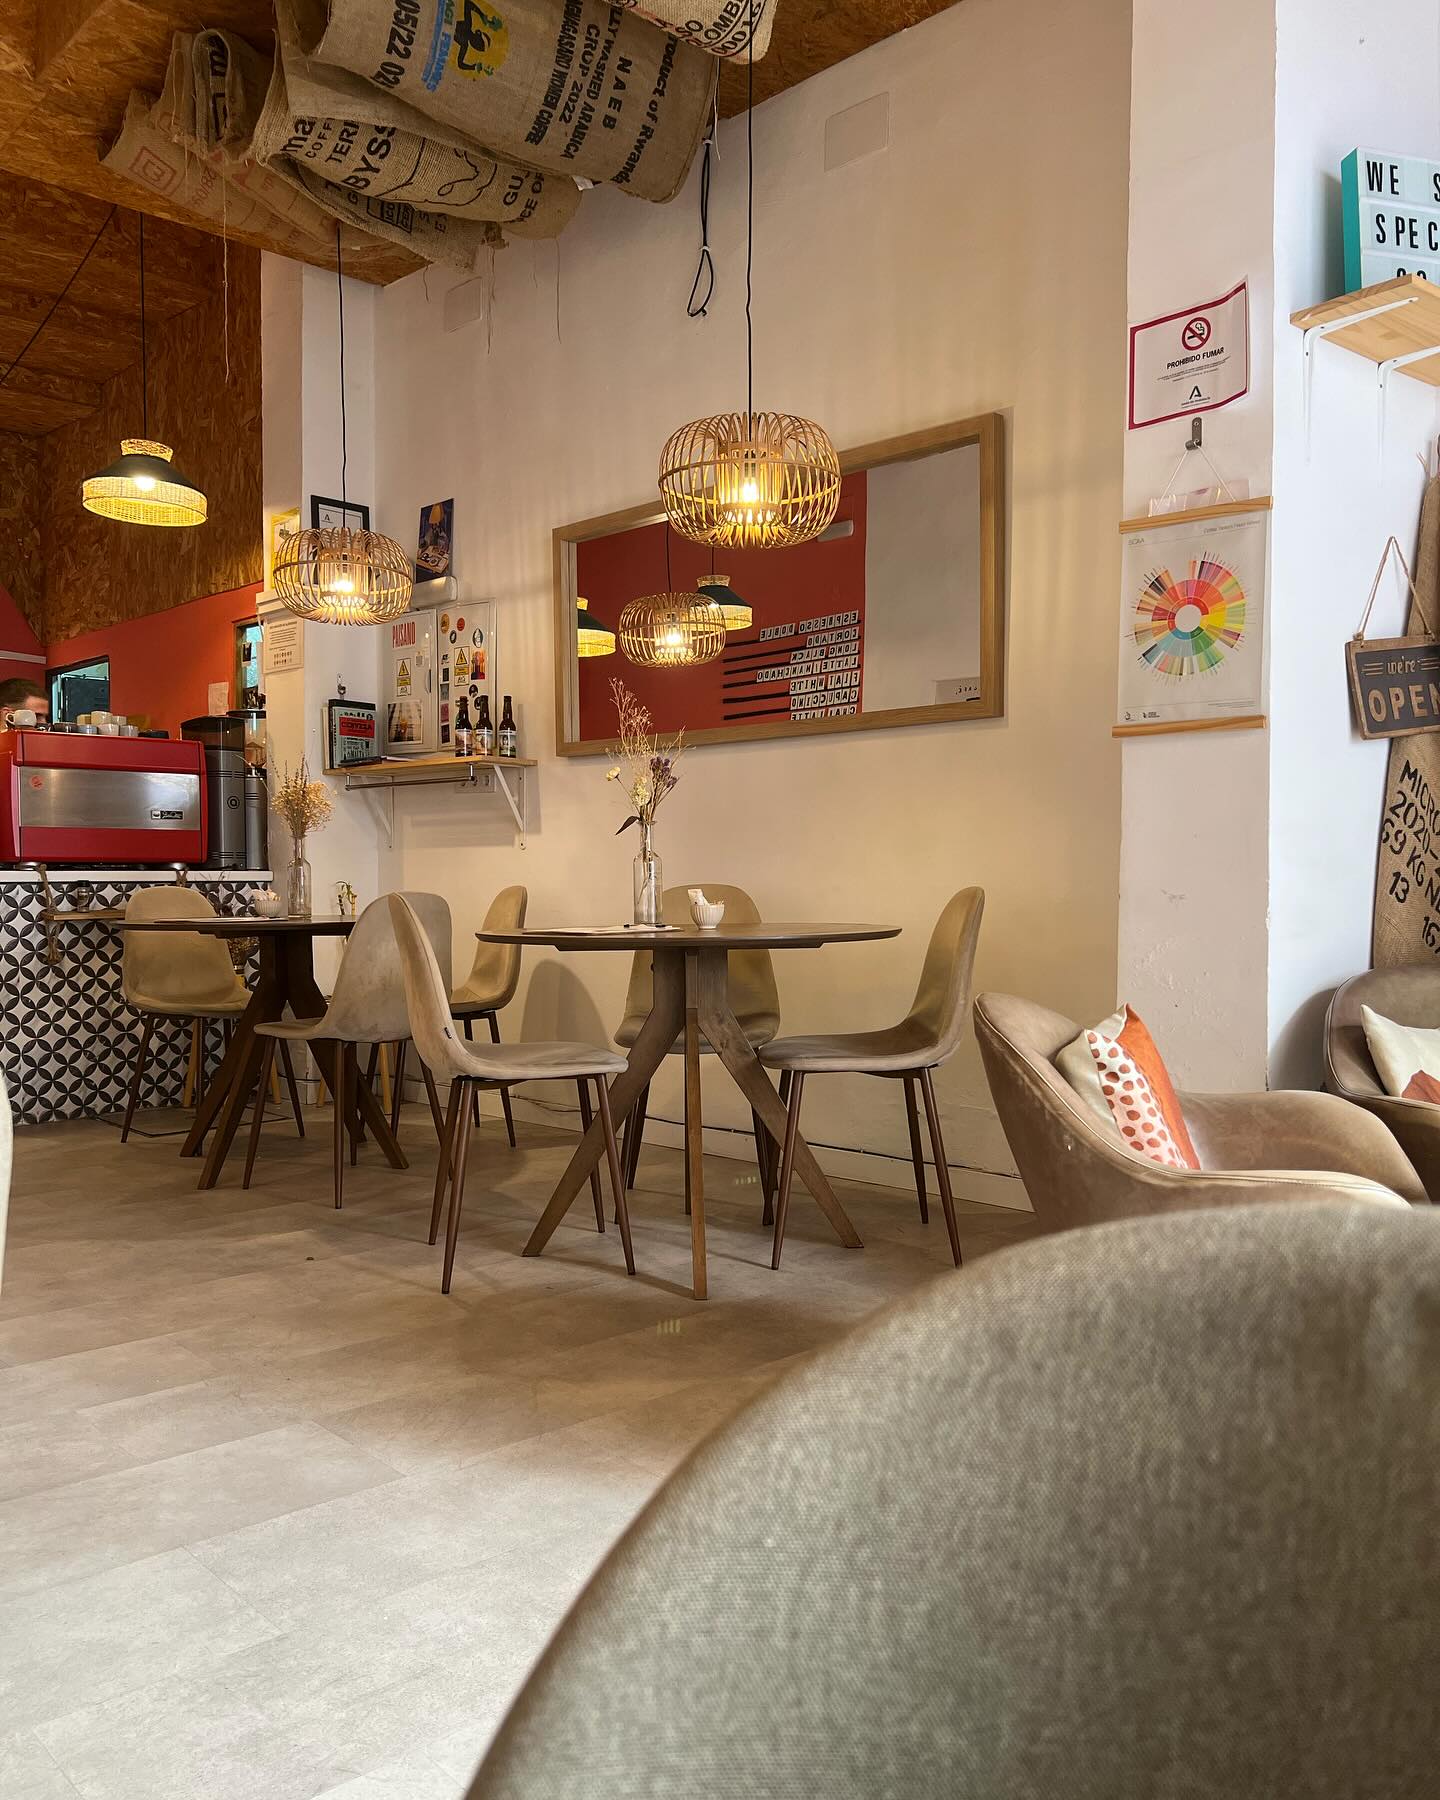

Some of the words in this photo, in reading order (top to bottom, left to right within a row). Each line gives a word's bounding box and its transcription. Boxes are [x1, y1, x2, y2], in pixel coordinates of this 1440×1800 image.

[579, 23, 601, 78] CROP
[586, 39, 615, 100] WASHED
[652, 32, 679, 98] roduct
[559, 80, 584, 124] 2022
[646, 99, 659, 124] of
[304, 118, 335, 159] COFF
[560, 100, 596, 160] ARABICA
[610, 123, 655, 184] Rwanda
[1366, 160, 1400, 196] WE
[1375, 213, 1439, 252] SPEC
[1166, 353, 1201, 370] PROHIBIDO
[1202, 346, 1225, 360] FUMAR
[1386, 655, 1416, 675] we're
[1368, 682, 1440, 722] OPEN
[1406, 845, 1426, 887] KG
[1388, 871, 1410, 904] 13
